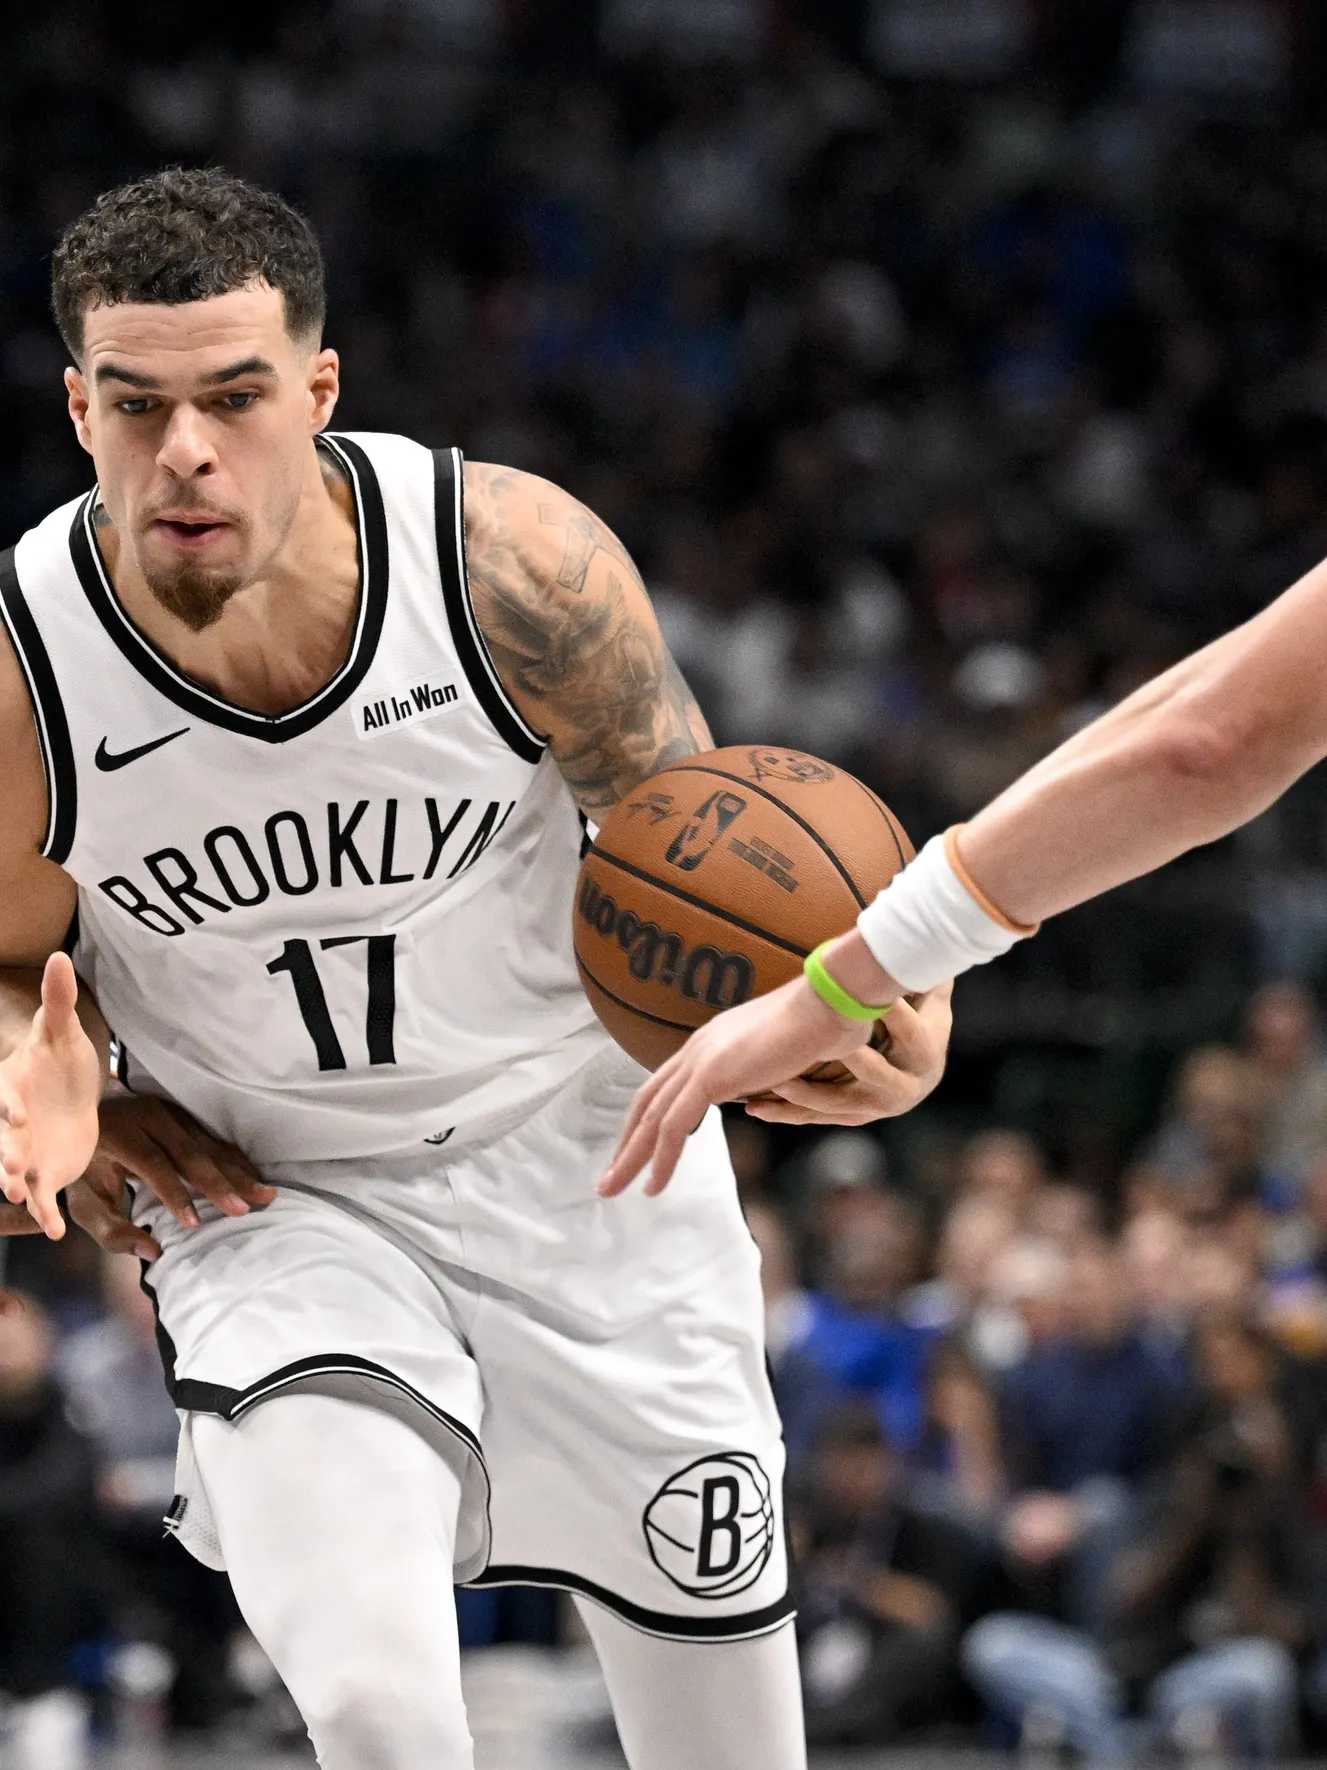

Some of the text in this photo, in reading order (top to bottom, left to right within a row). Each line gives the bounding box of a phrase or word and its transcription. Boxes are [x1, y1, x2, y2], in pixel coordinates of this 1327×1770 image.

[363, 683, 458, 731] All In Won
[98, 798, 516, 936] BROOKLYN
[265, 933, 397, 1071] 17
[579, 874, 756, 1009] Wilson
[697, 1476, 741, 1576] B
